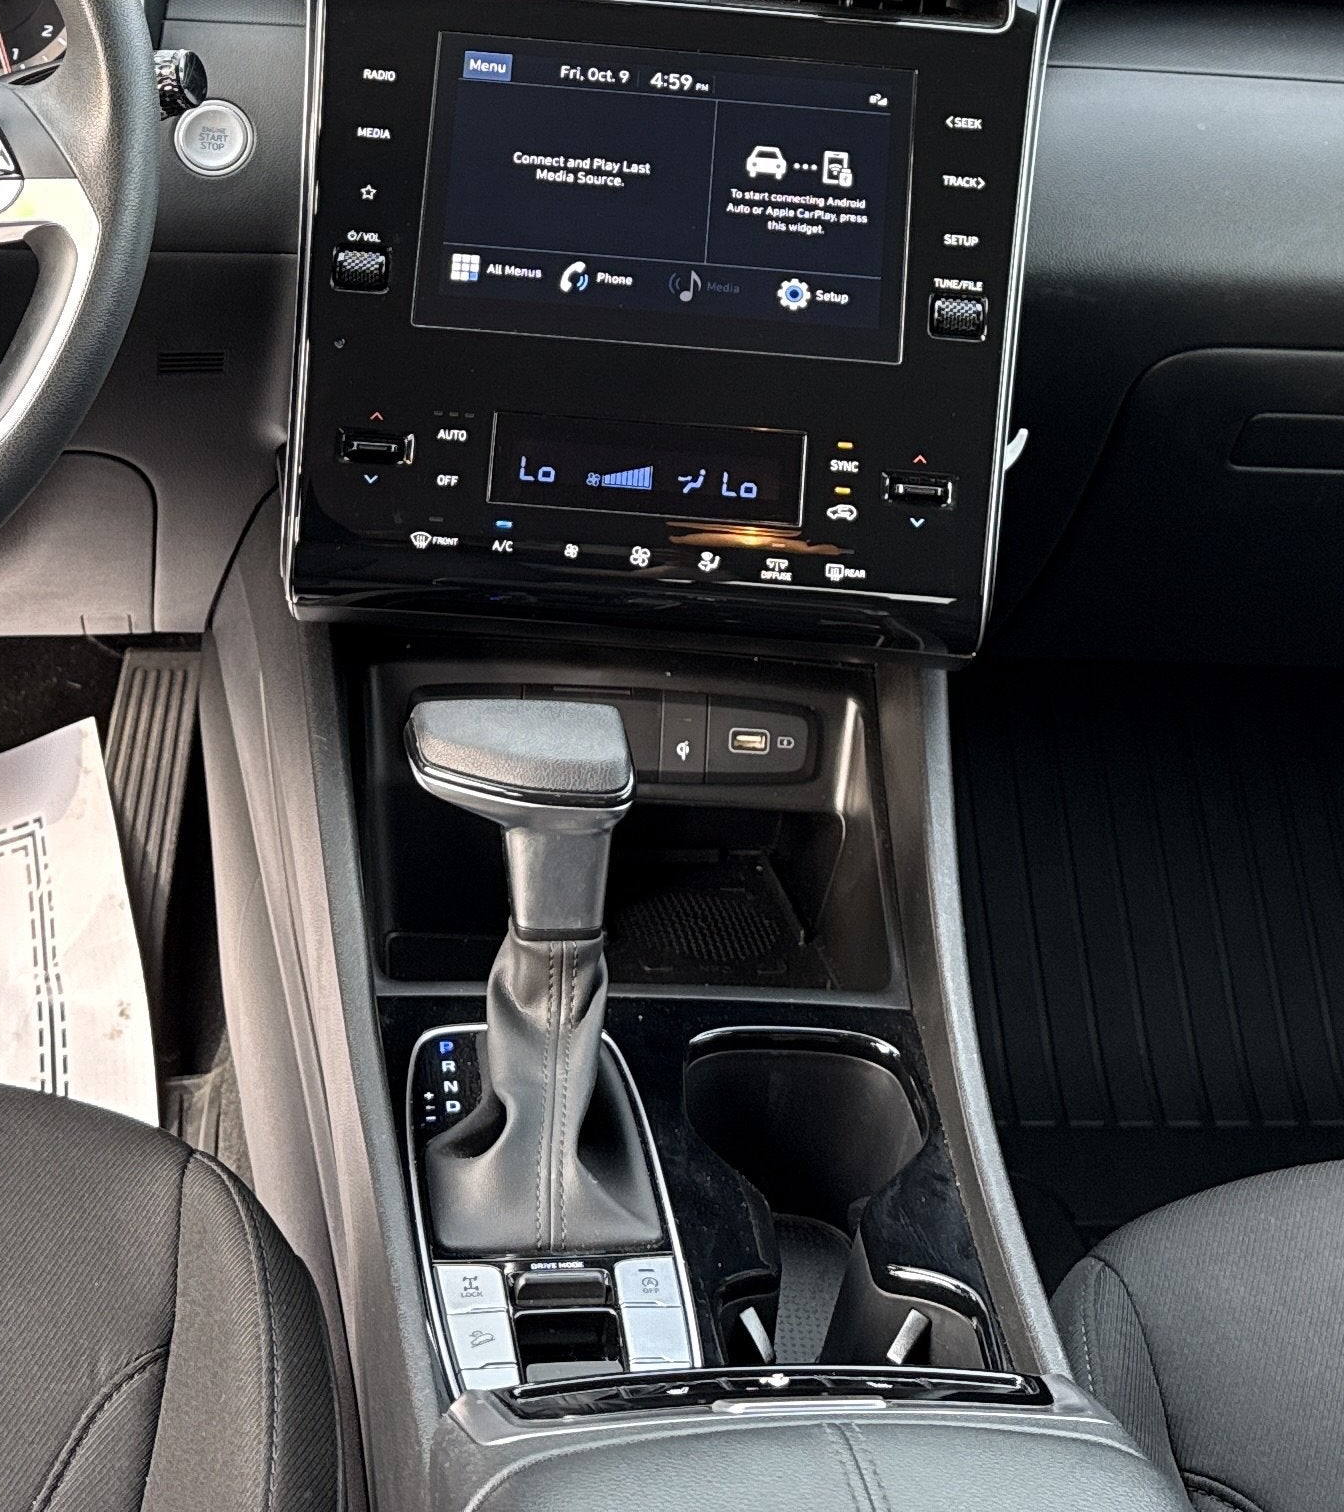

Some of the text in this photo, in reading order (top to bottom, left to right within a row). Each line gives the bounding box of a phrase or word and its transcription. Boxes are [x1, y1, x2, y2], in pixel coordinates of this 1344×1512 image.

[41, 25, 54, 38] 2
[11, 48, 20, 60] 1
[469, 58, 507, 74] Menu
[363, 69, 396, 81] RADIO
[587, 67, 616, 83] Oct.
[619, 70, 630, 84] 9
[650, 72, 693, 91] 4:59
[198, 133, 229, 143] START
[357, 126, 391, 139] MEDIA
[199, 141, 225, 151] STOP
[513, 151, 651, 175] Connect and Play Last
[536, 168, 625, 187] Media Source.
[730, 188, 866, 209] To start connecting Android
[726, 202, 751, 214] Auto
[752, 206, 763, 215] or
[765, 205, 795, 219] Apple
[839, 214, 868, 224] press
[767, 220, 825, 235] this widget.
[943, 233, 979, 247] SETUP
[486, 263, 542, 279] All Menus
[596, 272, 633, 286] Phone
[933, 277, 983, 291] TUNE/FILE
[706, 282, 740, 293] Media
[815, 290, 849, 305] Setup
[437, 428, 467, 442] AUTO
[830, 460, 859, 473] SYNC
[436, 474, 459, 486] OFF
[432, 536, 459, 546] FRONT
[492, 540, 514, 552] A/C
[439, 1041, 454, 1054] P
[441, 1060, 456, 1073] R
[443, 1080, 459, 1093] N
[445, 1100, 461, 1113] D
